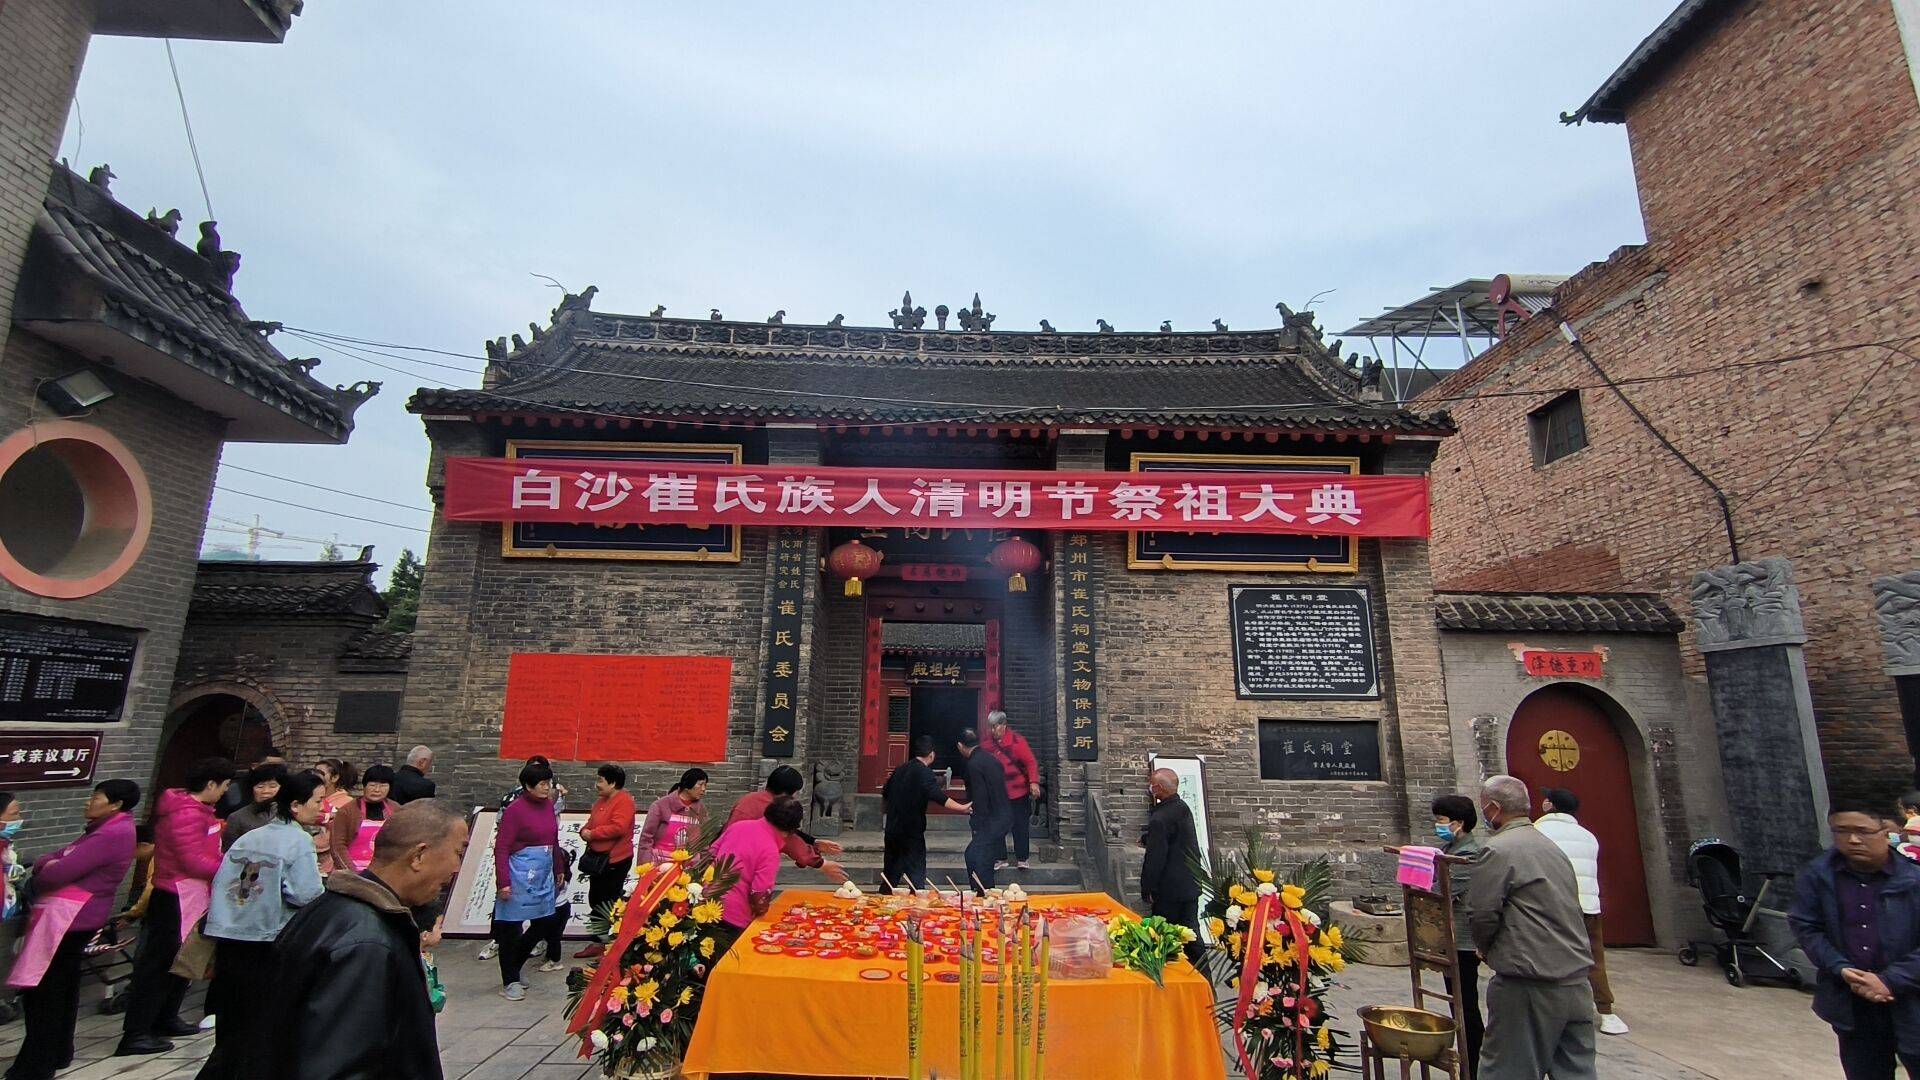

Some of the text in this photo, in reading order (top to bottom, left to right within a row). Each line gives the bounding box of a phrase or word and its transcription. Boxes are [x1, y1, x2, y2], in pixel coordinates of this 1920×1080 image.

[511, 468, 1362, 526] 白沙崔氏族人清明节祭祖大典
[769, 599, 797, 742] 崔氏委员会
[1069, 533, 1094, 750] 郑州市崔氏祠堂文物保护所
[1282, 740, 1353, 755] 崔氏祠堂
